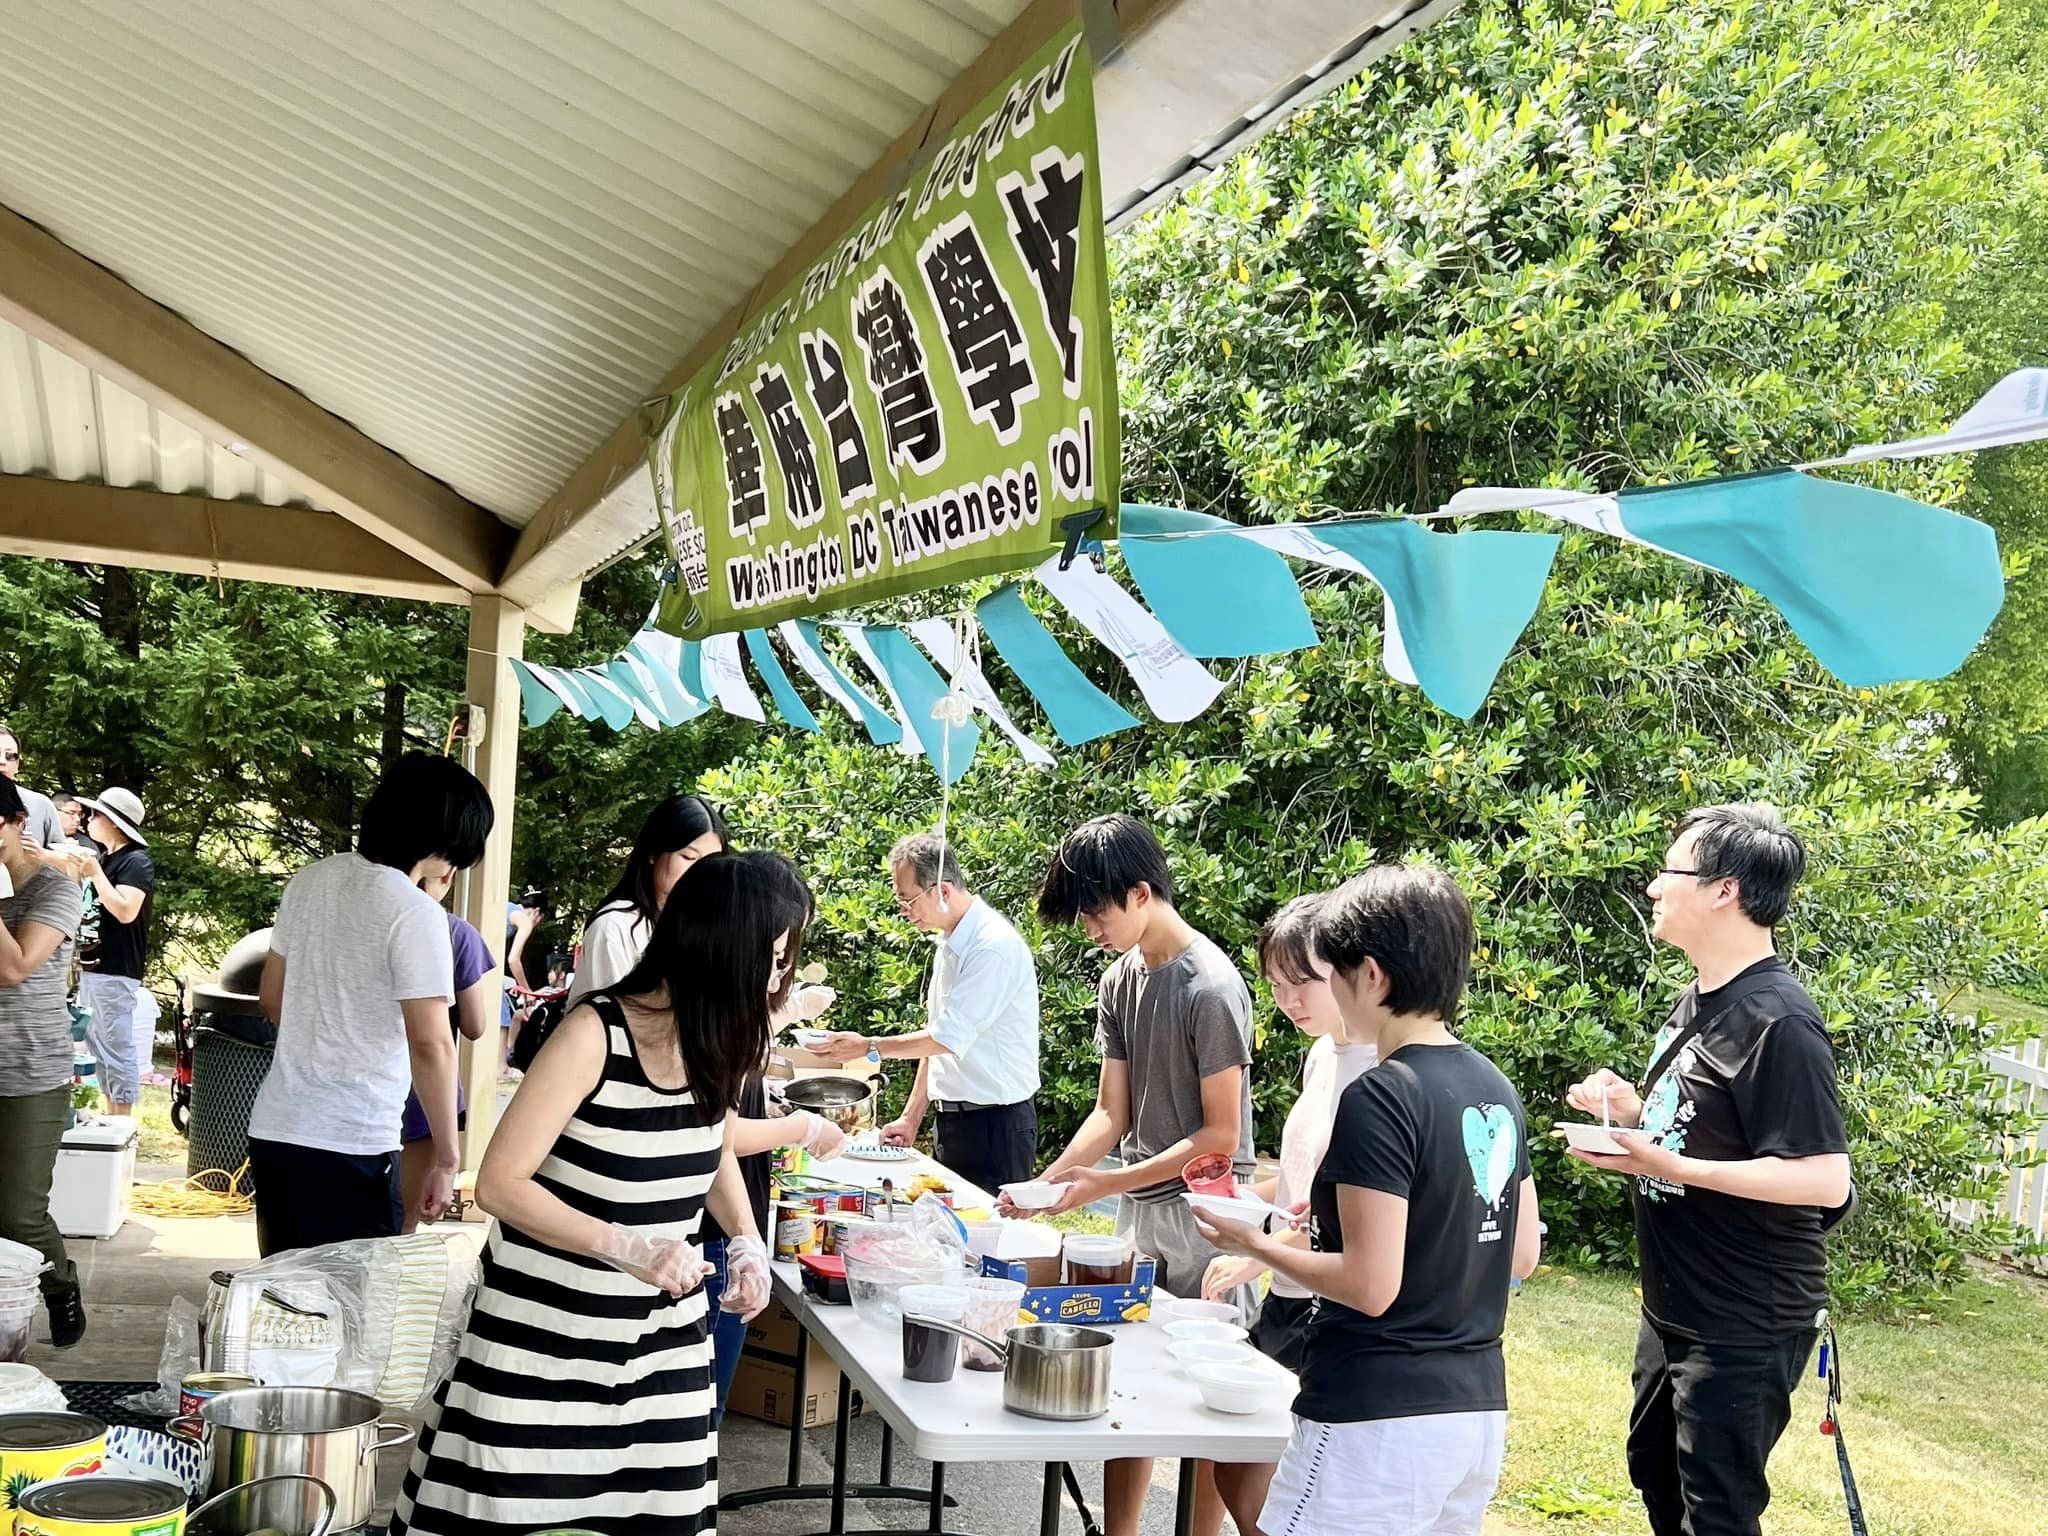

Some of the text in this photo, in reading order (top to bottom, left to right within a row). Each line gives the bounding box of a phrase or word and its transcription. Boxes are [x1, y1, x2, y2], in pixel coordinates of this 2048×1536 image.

[851, 517, 877, 569] DC
[882, 472, 1038, 557] Taiwanese
[1062, 1301, 1099, 1315] CABELLO
